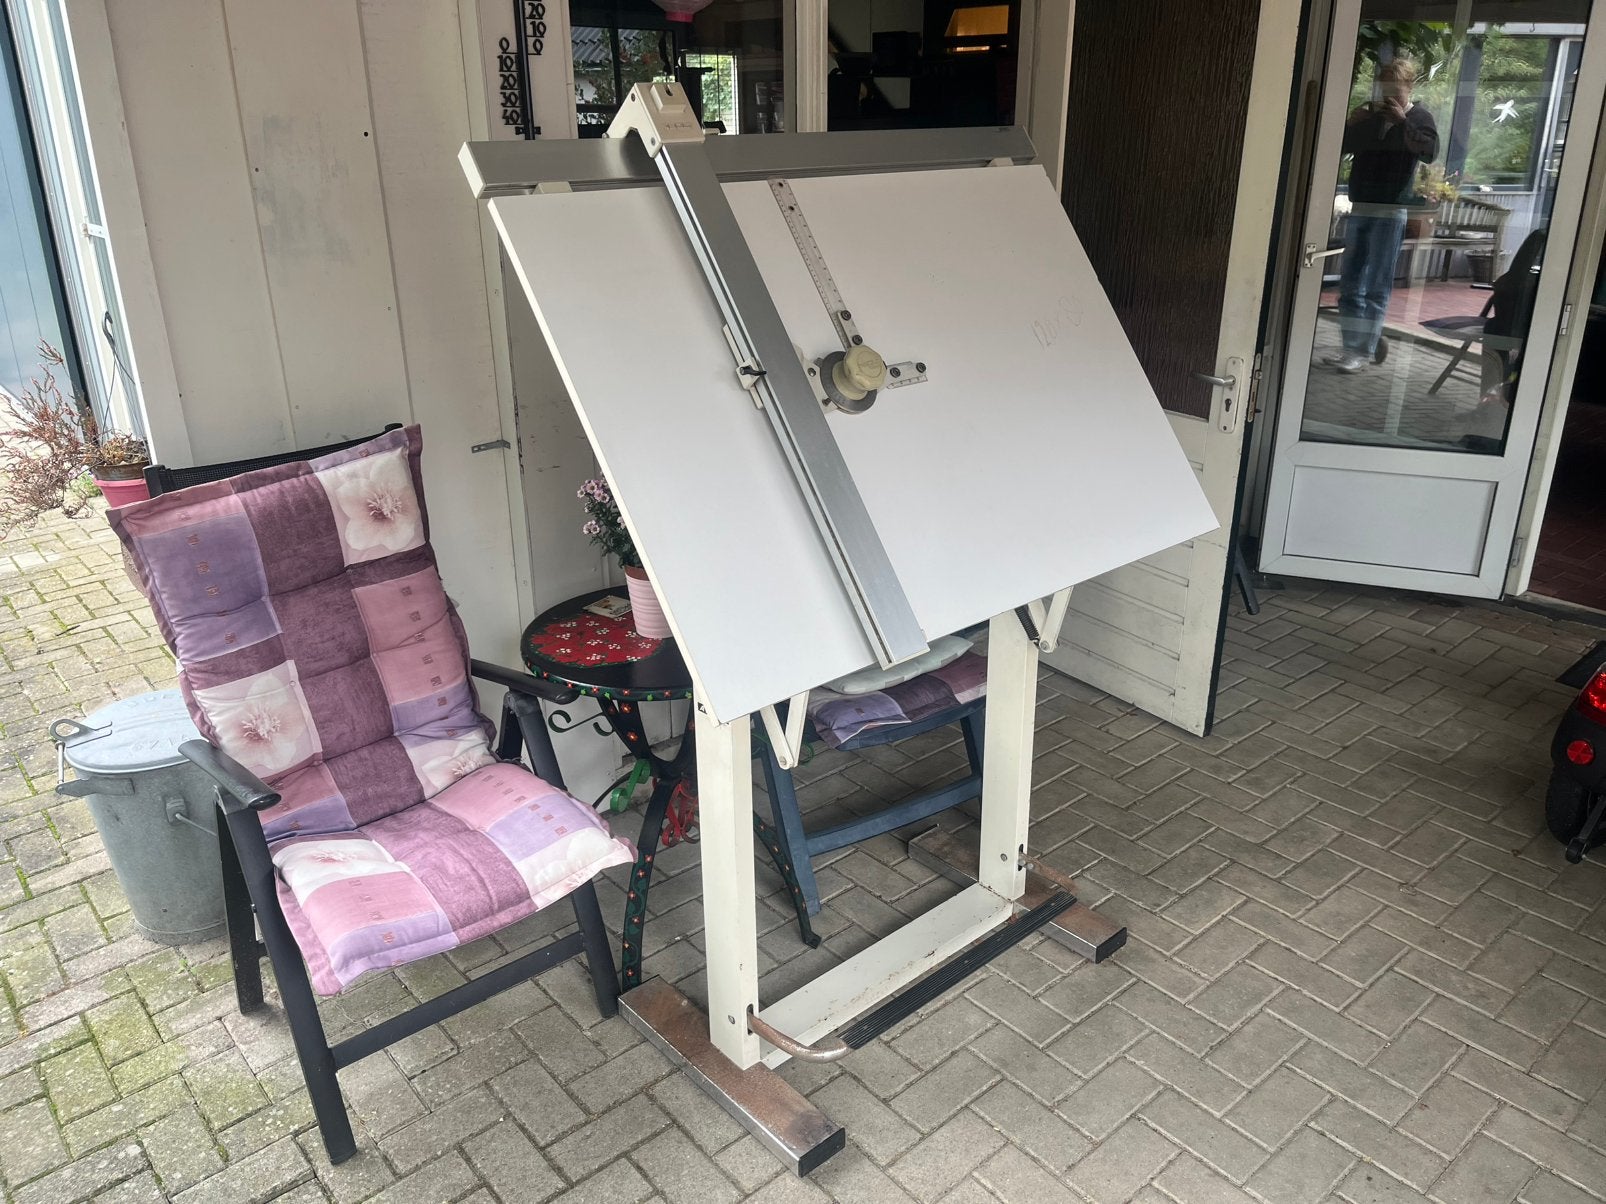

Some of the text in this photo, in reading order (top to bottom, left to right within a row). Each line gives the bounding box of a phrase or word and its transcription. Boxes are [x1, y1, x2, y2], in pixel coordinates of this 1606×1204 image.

[528, 2, 546, 19] 20
[530, 21, 547, 37] 10
[499, 37, 510, 53] 0
[533, 39, 544, 54] 0
[497, 55, 514, 71] 10
[499, 74, 517, 90] 20
[500, 92, 519, 107] 30
[502, 109, 520, 125] 40
